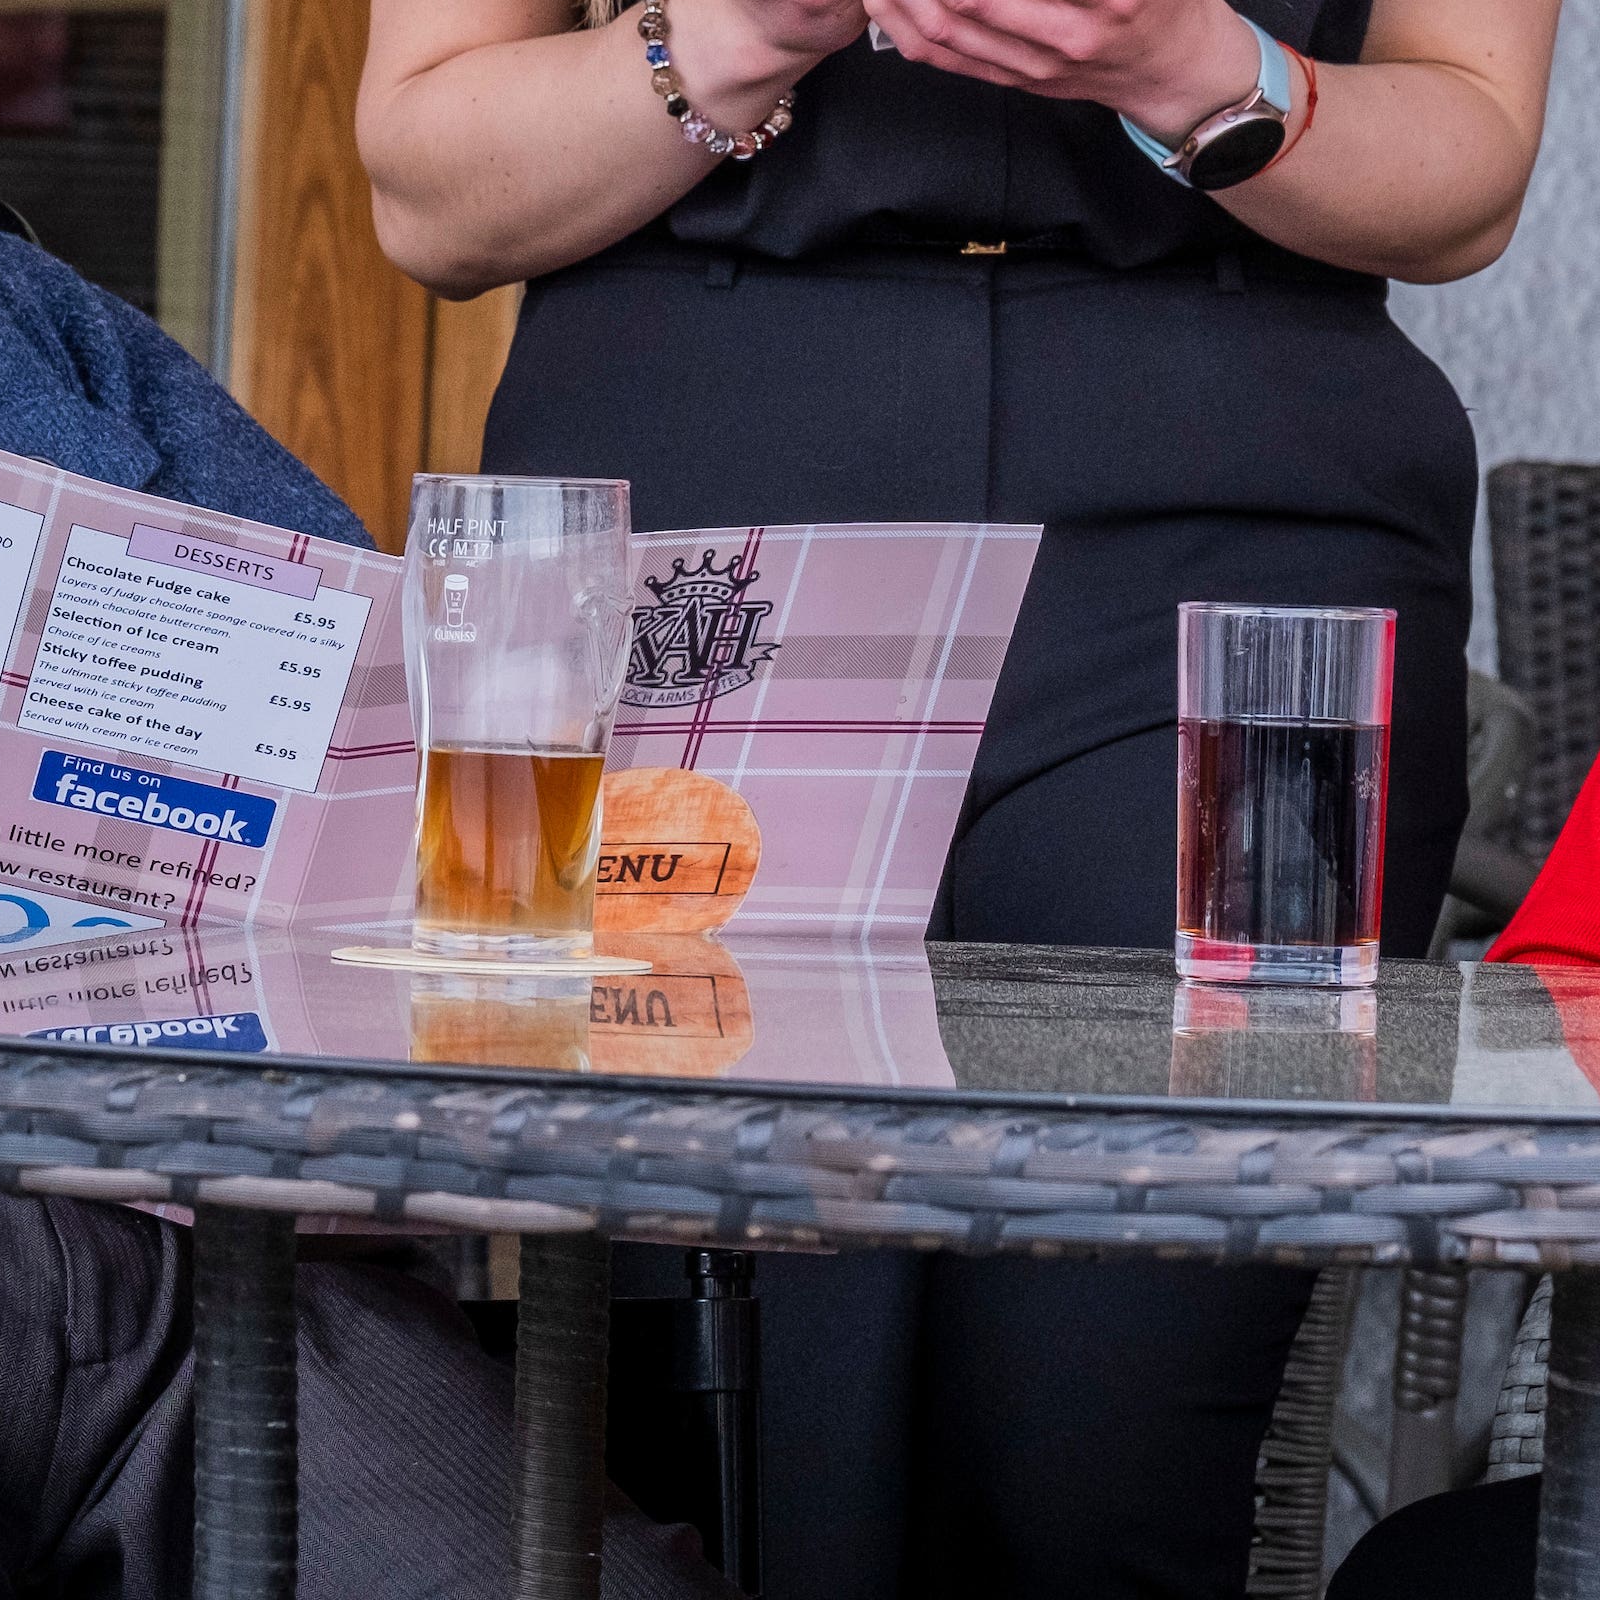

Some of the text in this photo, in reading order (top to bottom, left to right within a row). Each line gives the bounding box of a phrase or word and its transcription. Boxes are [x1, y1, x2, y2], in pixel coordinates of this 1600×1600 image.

[427, 517, 508, 537] HALF PINT
[67, 556, 231, 605] Chocolate Fudge cake
[174, 543, 275, 581] DESSERTS
[52, 606, 219, 655] Selection of Ice cream
[56, 592, 231, 638] smooth chocolate buttercream.
[61, 575, 98, 591] Layers
[100, 586, 114, 596] of
[112, 588, 148, 604] fudgy
[149, 597, 204, 616] chocolate
[206, 611, 247, 626] sponge
[249, 622, 296, 638] covered
[295, 631, 307, 641] in
[319, 637, 345, 651] silky
[292, 611, 336, 630] £5.95
[48, 625, 161, 658] Choice of ice creams
[39, 660, 227, 712] The ultimate sticky toffee pudding
[42, 642, 204, 690] Sticky toffee pudding
[277, 660, 321, 679] £5.95
[33, 677, 155, 710] served with ice cream
[268, 694, 311, 712] £5.95
[23, 710, 198, 756] Served with cream or ice cream
[29, 692, 203, 741] Cheese cake of the day
[62, 754, 161, 789] Find us on
[253, 742, 297, 760] £5.95
[55, 772, 249, 843] facebook
[8, 824, 66, 853] little
[73, 842, 142, 869] more
[149, 858, 257, 893] refined?
[597, 853, 683, 884] ENU
[28, 867, 176, 911] restaurant?
